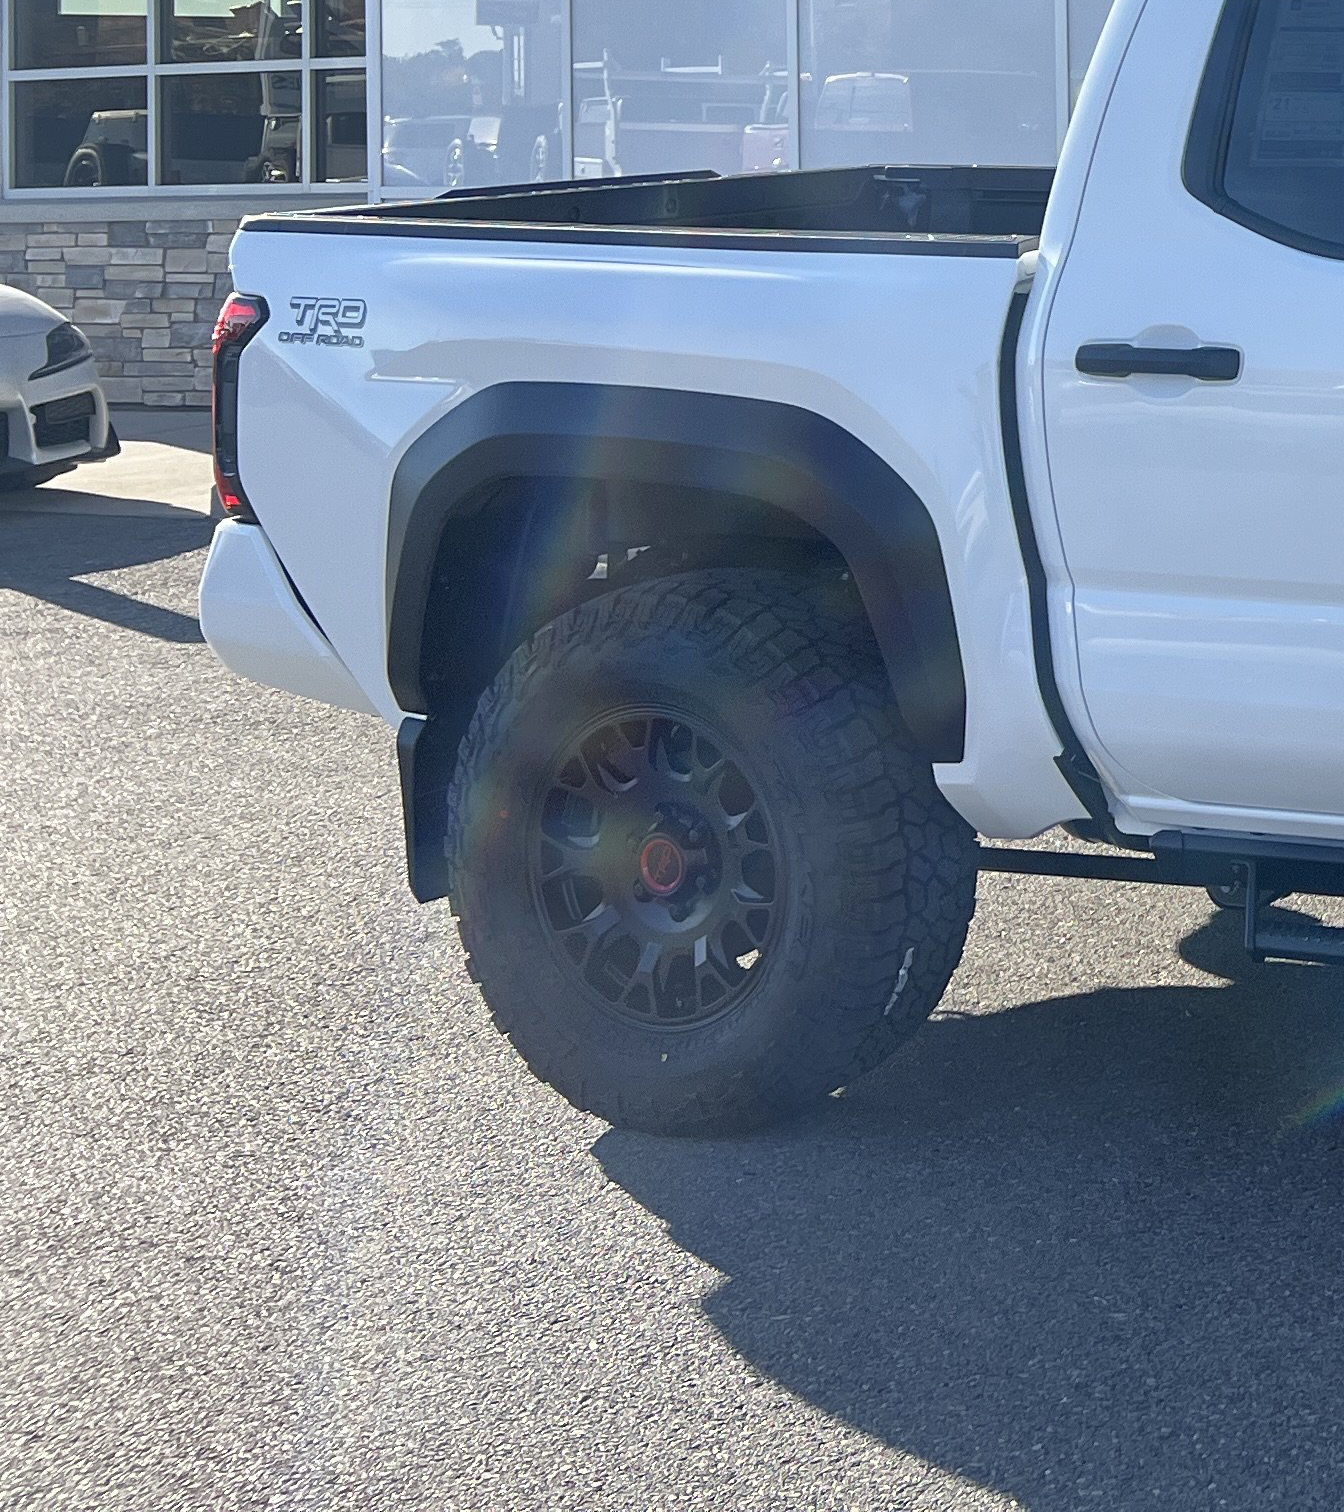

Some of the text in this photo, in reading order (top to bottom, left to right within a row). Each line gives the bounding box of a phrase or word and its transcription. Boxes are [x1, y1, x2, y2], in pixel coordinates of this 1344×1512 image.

[290, 296, 367, 335] TRD
[278, 331, 365, 348] OFF ROAD
